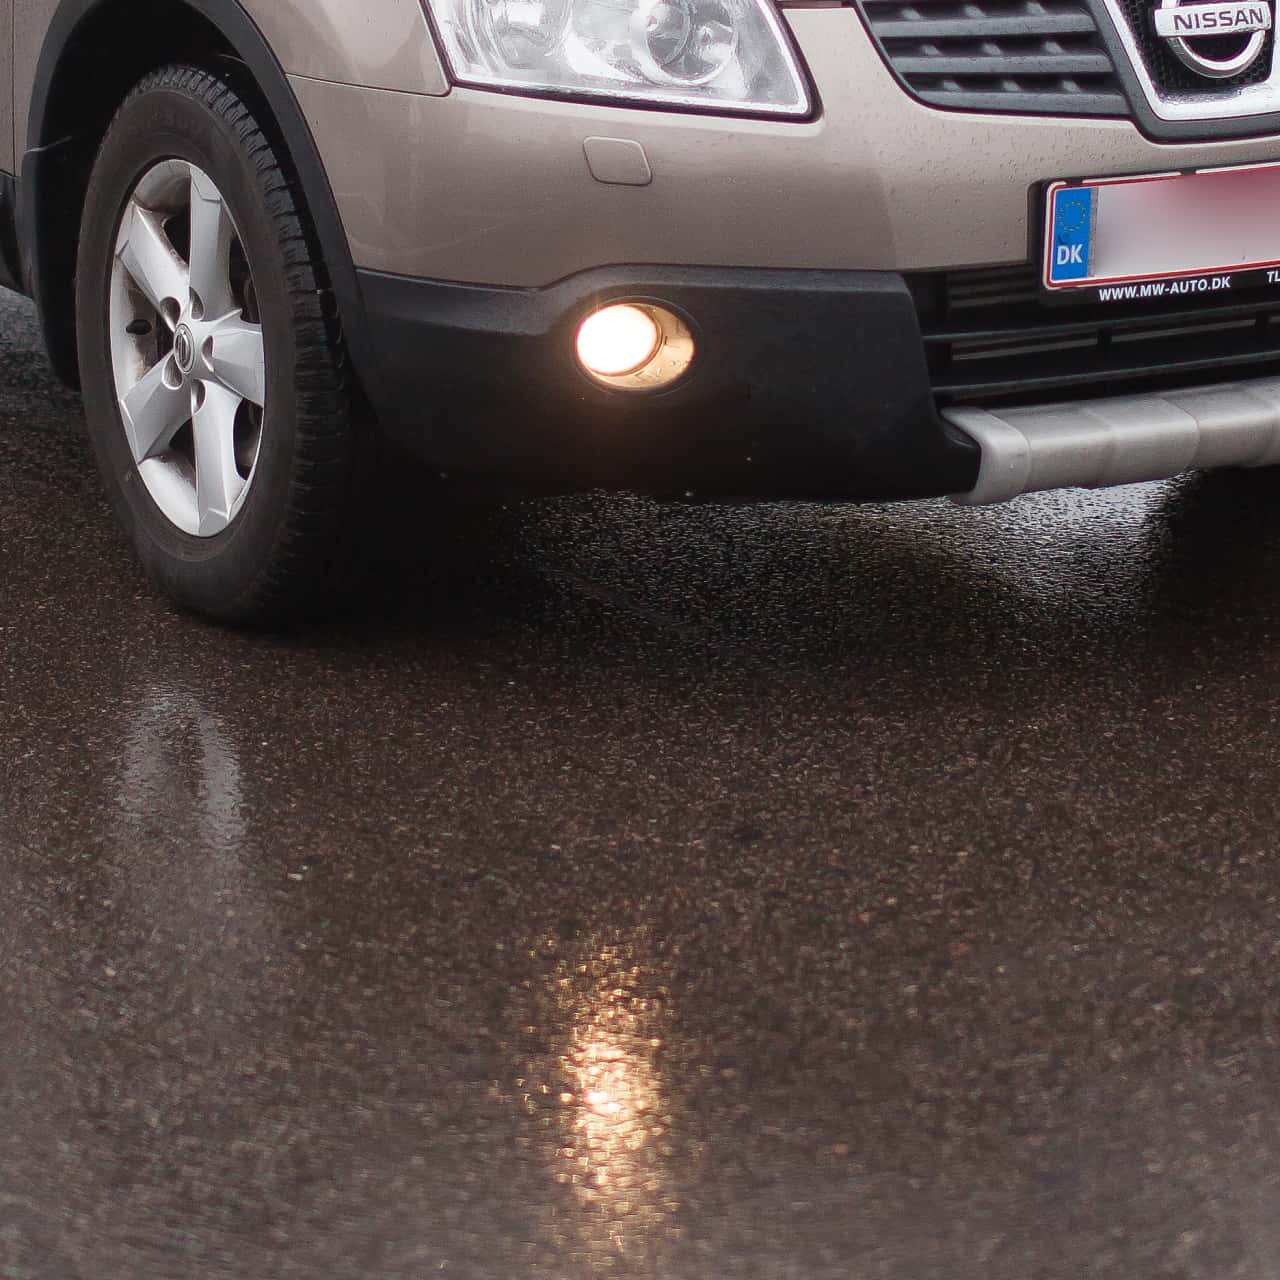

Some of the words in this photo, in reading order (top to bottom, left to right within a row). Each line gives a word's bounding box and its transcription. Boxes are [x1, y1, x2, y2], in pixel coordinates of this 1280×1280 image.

[1173, 8, 1263, 30] NISSAN
[1056, 245, 1083, 266] DK
[1099, 276, 1230, 301] WWW.MW-AUTO.DK
